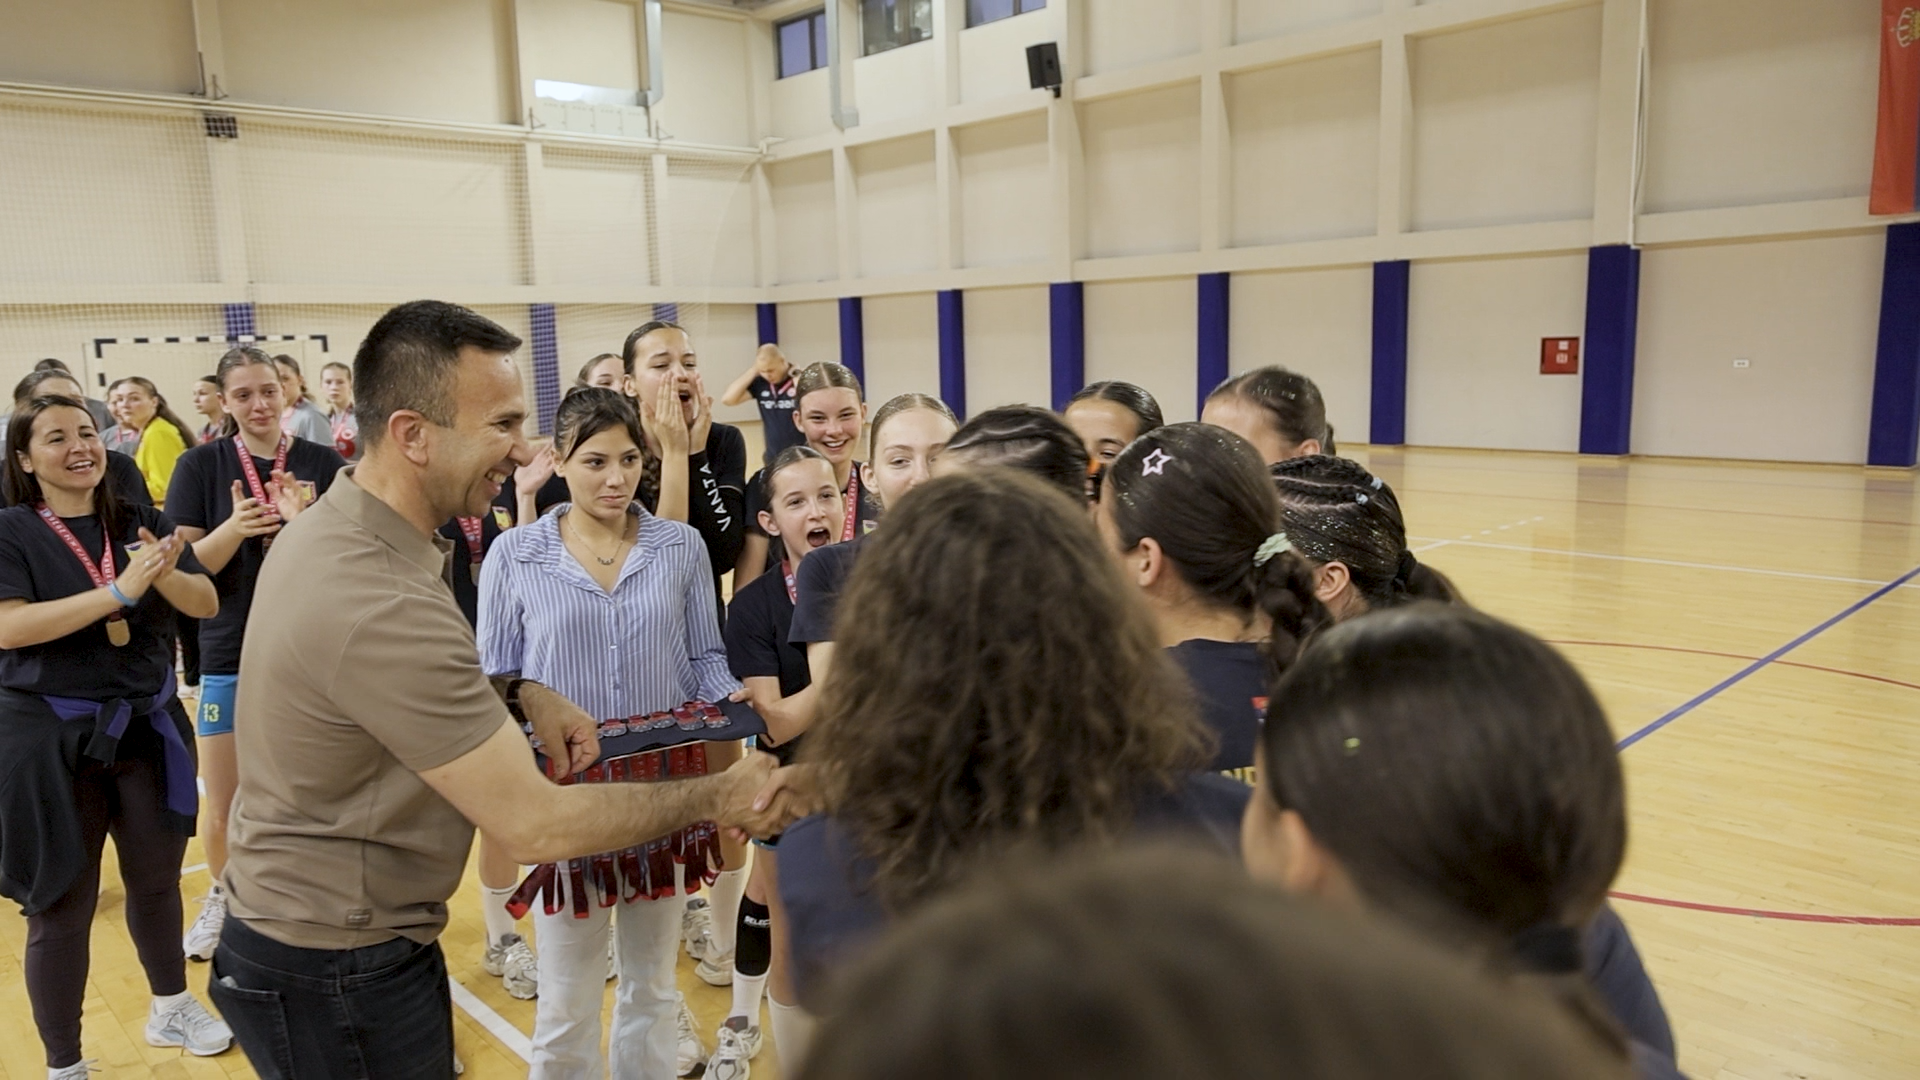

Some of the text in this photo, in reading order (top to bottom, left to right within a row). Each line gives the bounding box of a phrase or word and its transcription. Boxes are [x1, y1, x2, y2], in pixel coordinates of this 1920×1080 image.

[699, 462, 731, 532] VANTA
[203, 702, 220, 722] 13
[744, 915, 771, 926] SELEC
